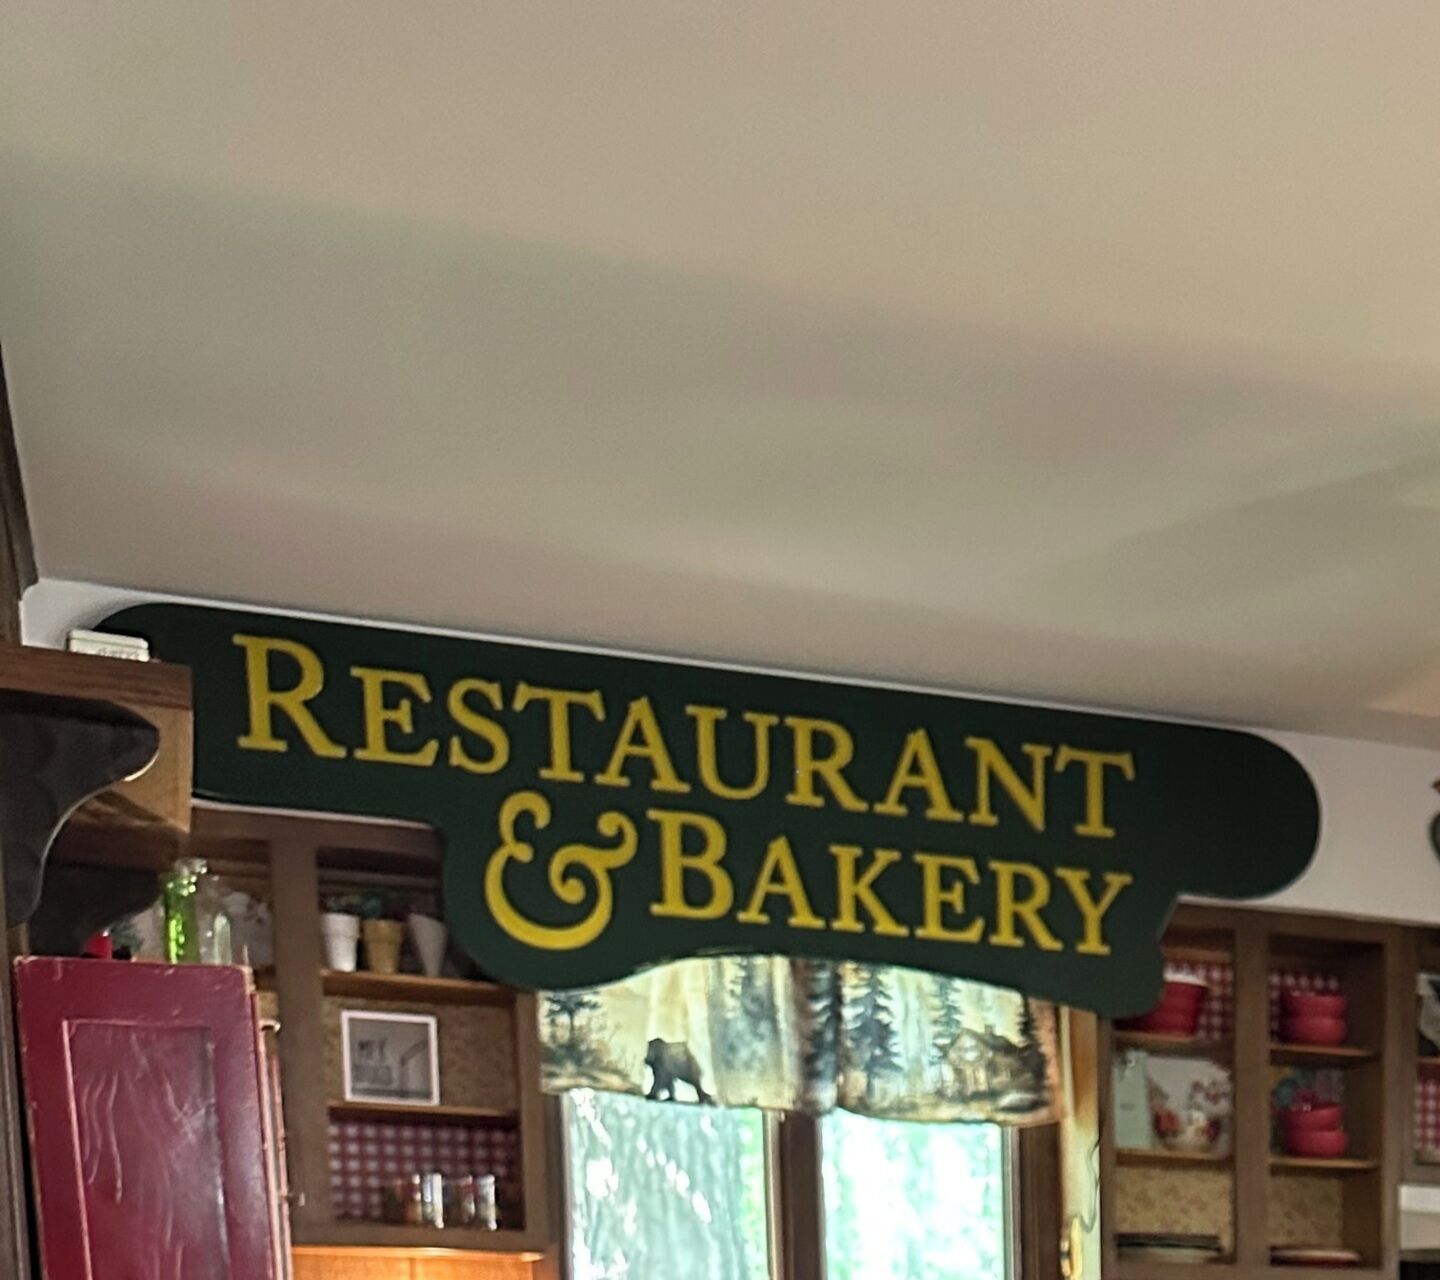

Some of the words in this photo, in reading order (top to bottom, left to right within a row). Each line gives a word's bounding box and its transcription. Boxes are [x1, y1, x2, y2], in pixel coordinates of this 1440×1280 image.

[233, 633, 1135, 838] RESTAURANT
[485, 790, 637, 950] &
[647, 808, 1133, 957] BAKERY
